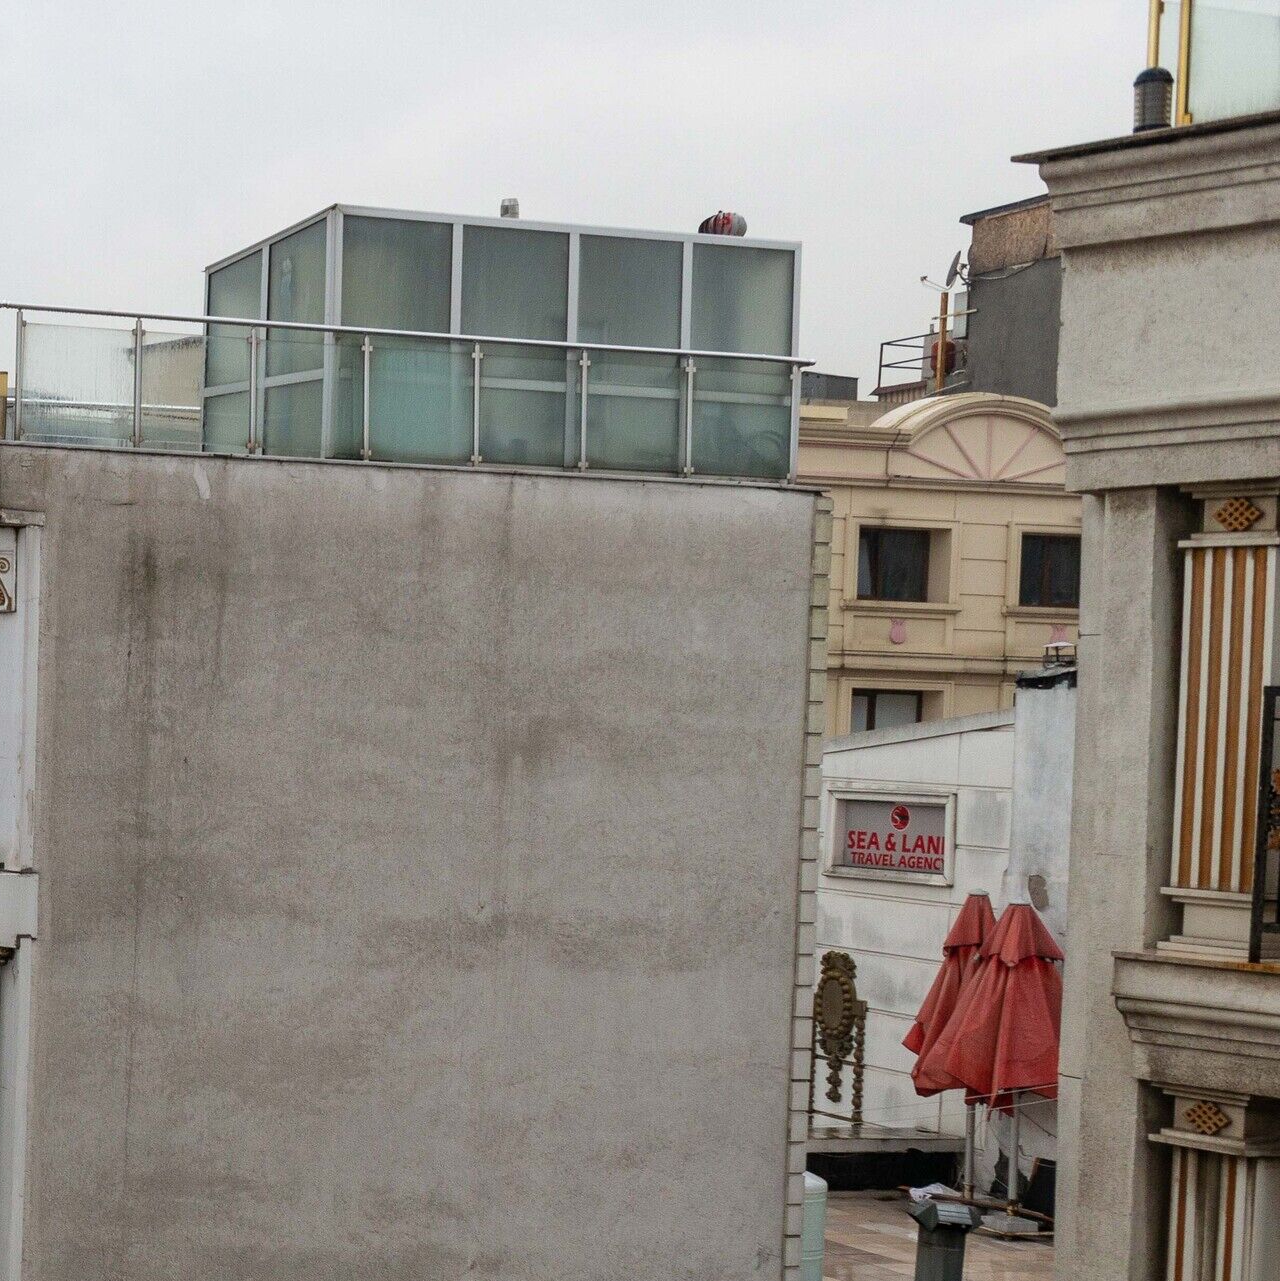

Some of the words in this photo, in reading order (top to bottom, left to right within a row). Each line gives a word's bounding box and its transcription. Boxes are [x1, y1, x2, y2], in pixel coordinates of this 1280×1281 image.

[847, 830, 880, 850] SEA
[884, 833, 897, 852] &
[851, 851, 896, 867] TRAVEL
